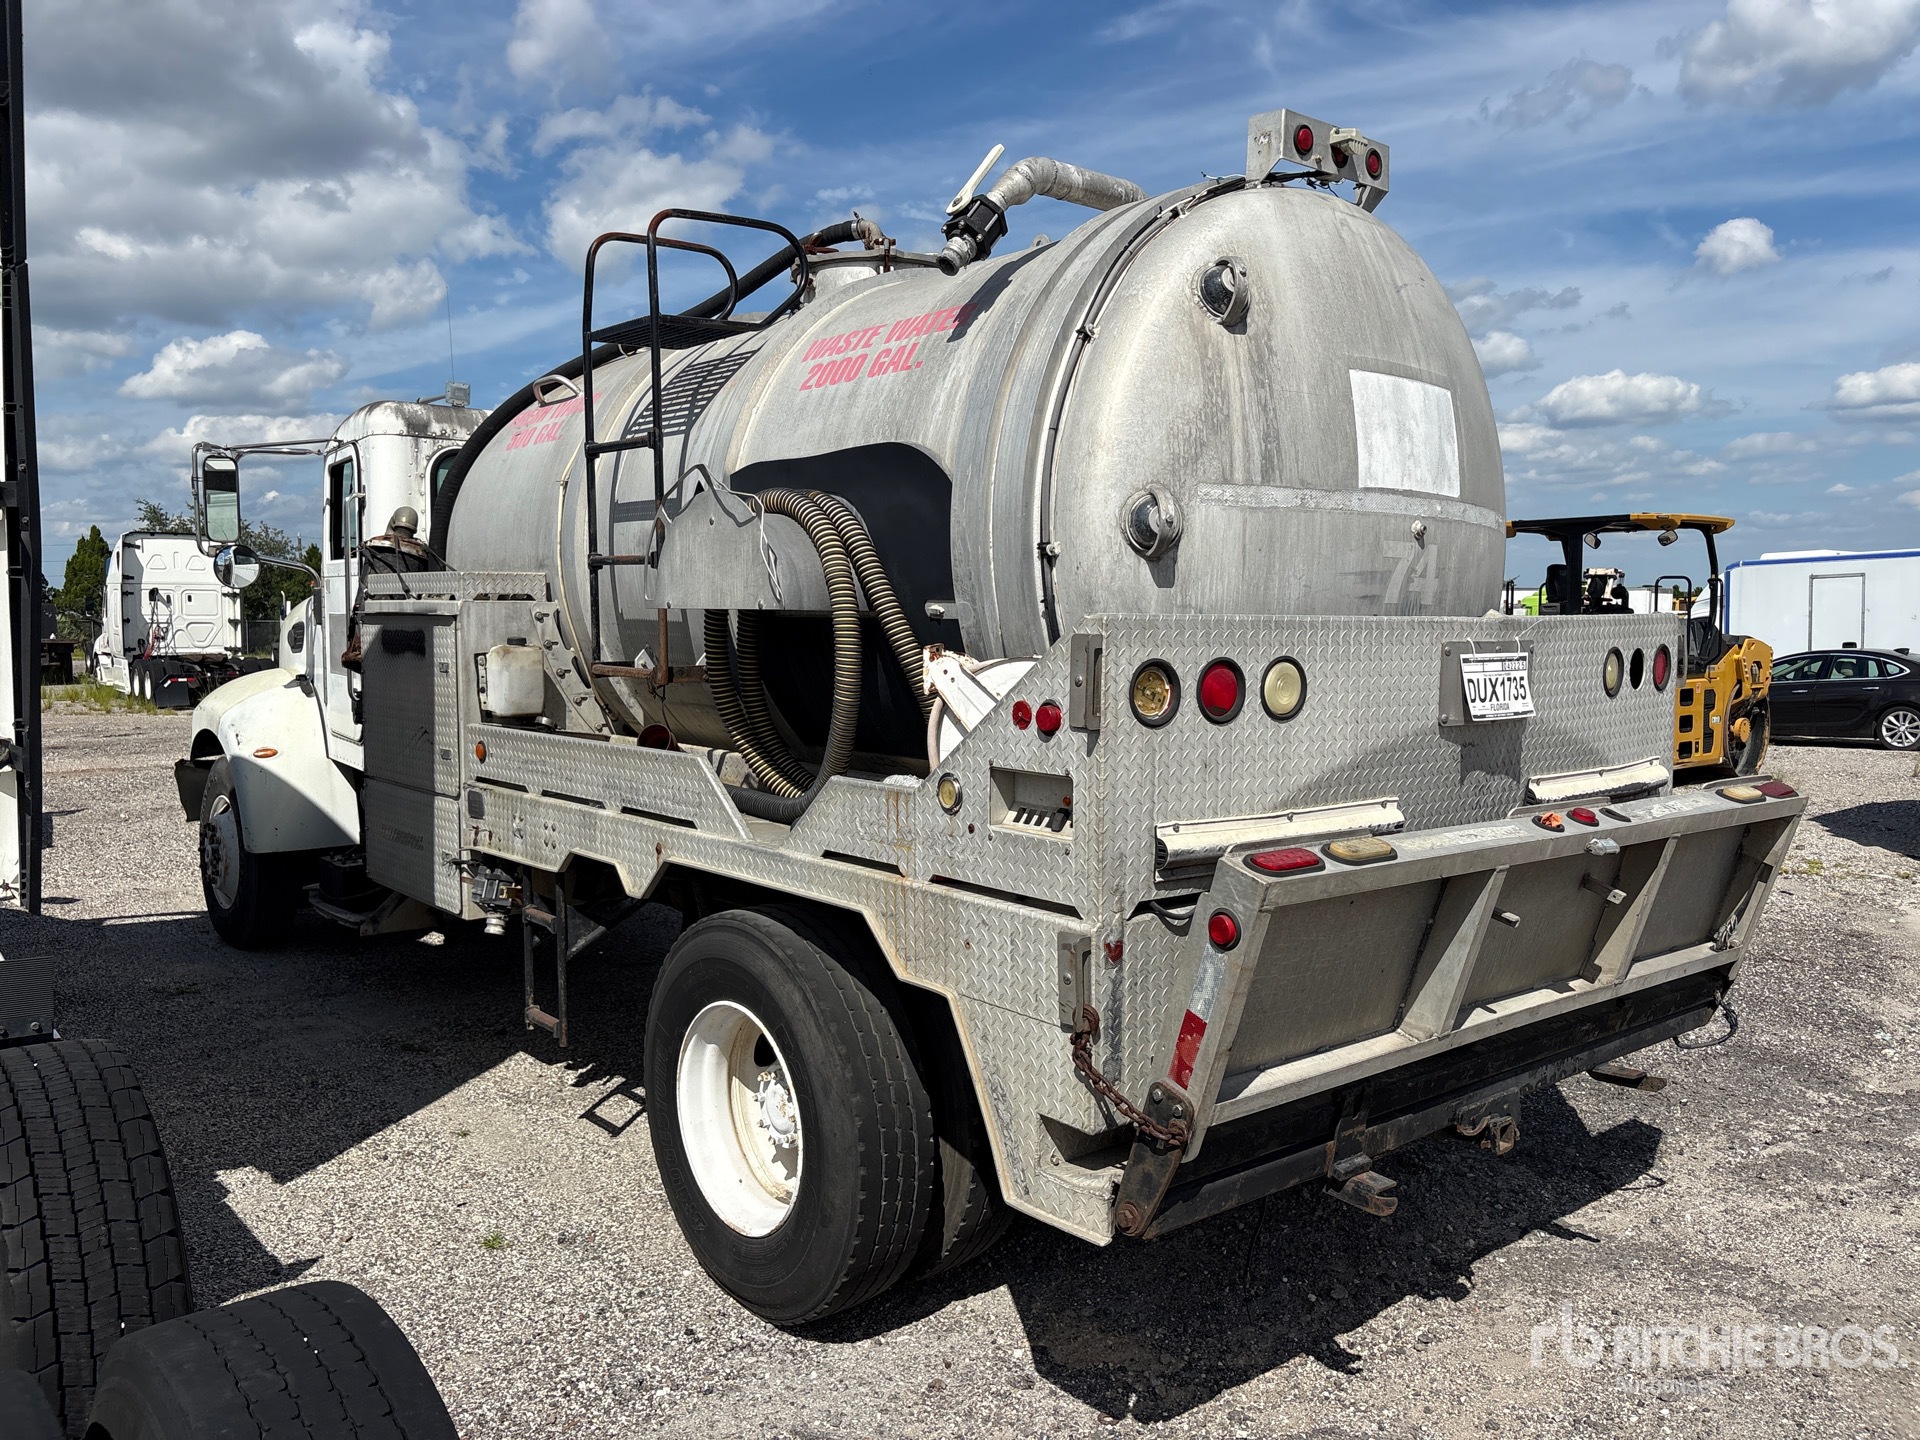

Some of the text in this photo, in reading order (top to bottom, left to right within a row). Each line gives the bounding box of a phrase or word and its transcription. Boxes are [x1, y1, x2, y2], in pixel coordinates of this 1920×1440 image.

[802, 303, 978, 362] WASTE WATER
[800, 342, 923, 391] 2000 GAL.
[1382, 540, 1440, 606] 74
[1466, 676, 1527, 703] DUX1735
